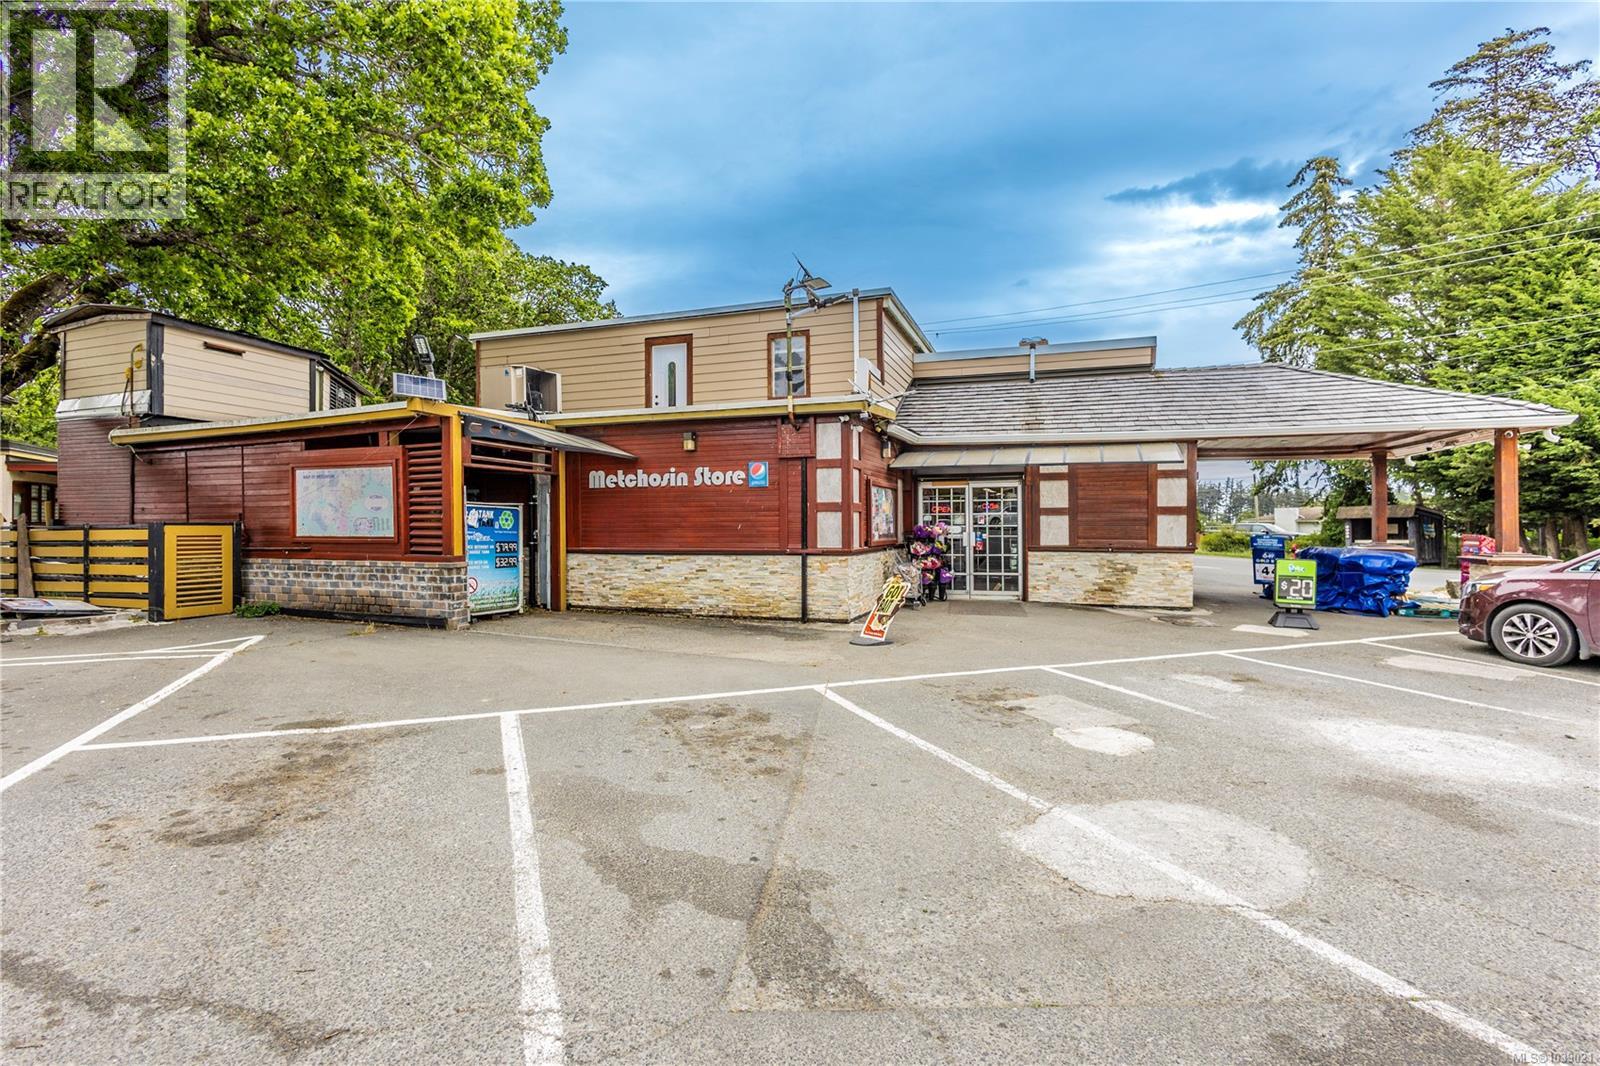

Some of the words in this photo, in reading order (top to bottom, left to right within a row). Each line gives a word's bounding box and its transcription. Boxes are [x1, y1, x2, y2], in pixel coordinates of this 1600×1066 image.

[588, 467, 689, 489] Metchosin
[693, 466, 746, 487] Store
[931, 505, 952, 513] OPEN
